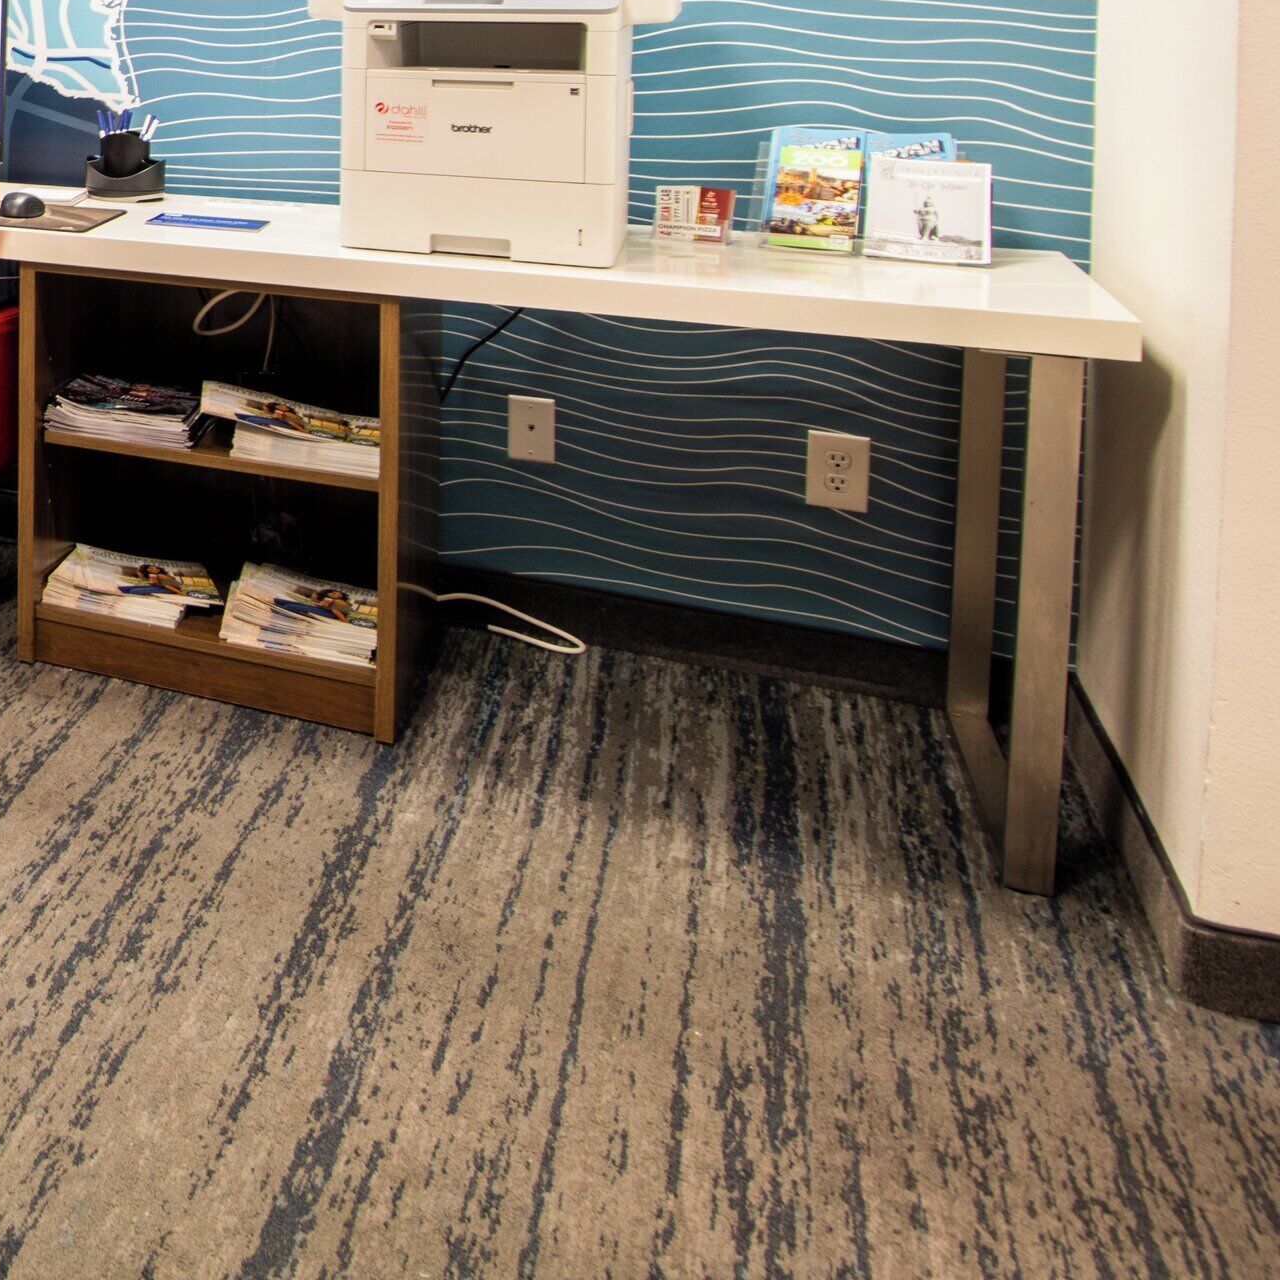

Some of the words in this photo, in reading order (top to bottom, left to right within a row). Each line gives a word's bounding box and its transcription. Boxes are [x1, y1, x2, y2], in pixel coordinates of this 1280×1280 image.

[451, 124, 493, 133] brother
[790, 152, 849, 167] ZOO
[660, 189, 672, 202] CAB
[658, 223, 696, 232] CHAMPION
